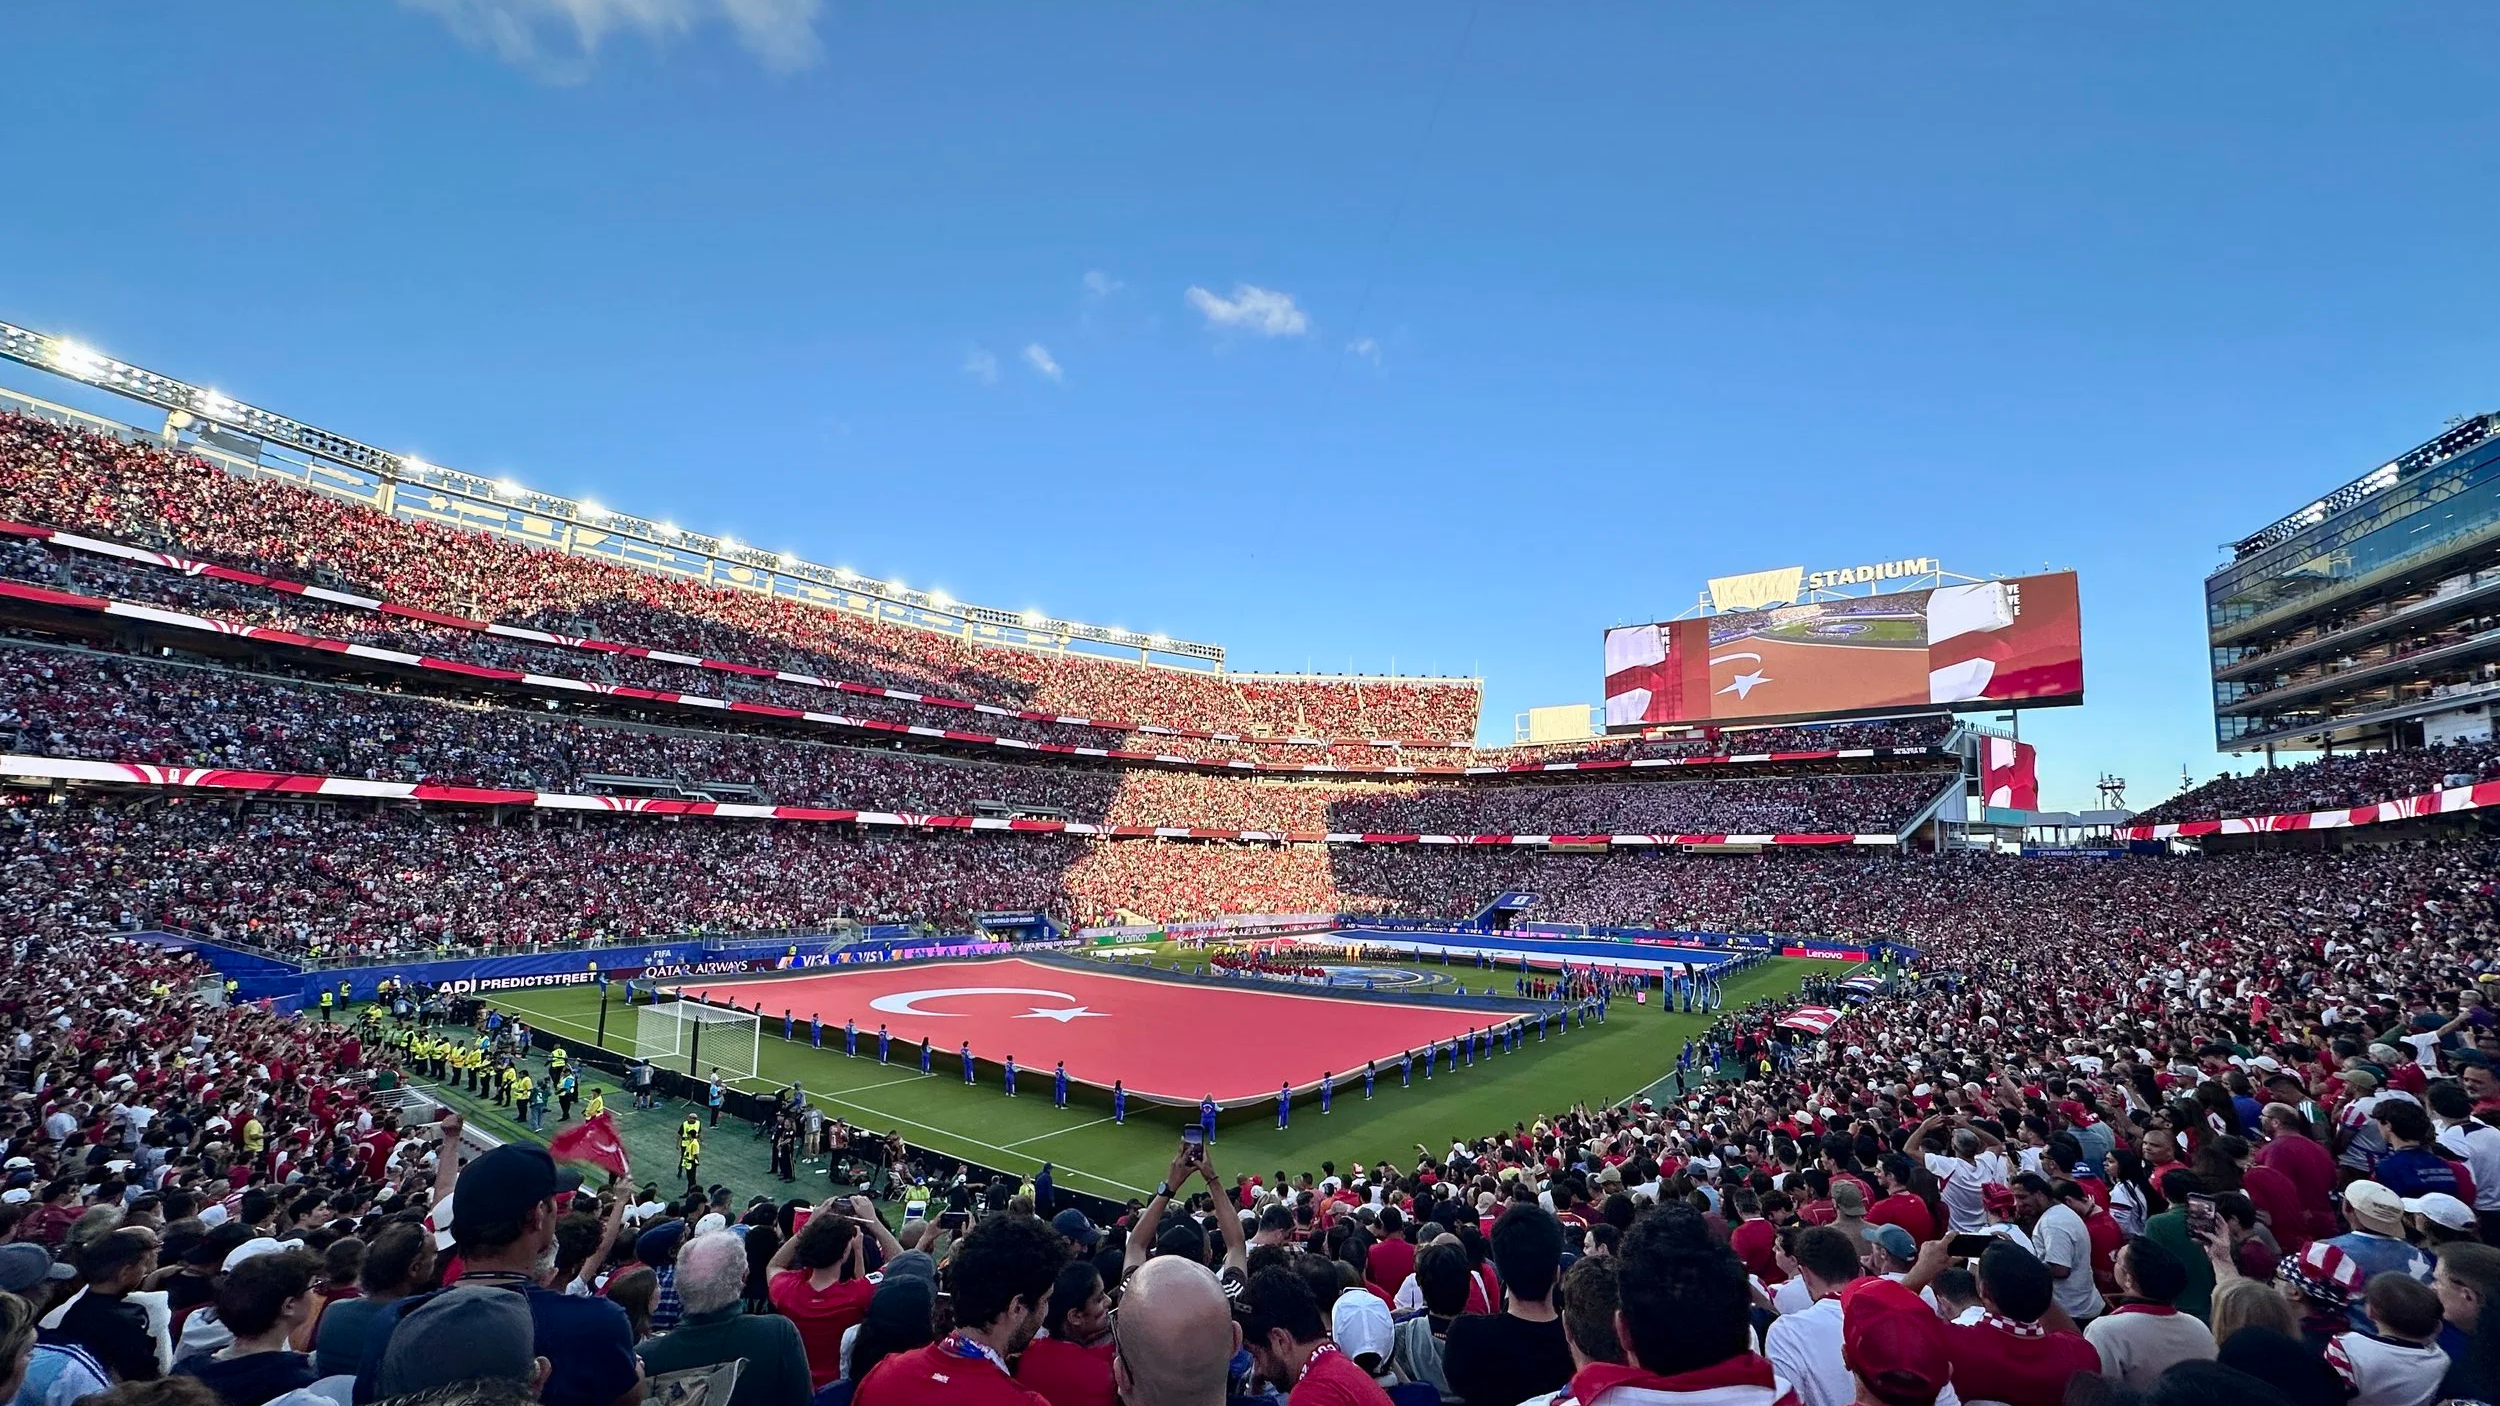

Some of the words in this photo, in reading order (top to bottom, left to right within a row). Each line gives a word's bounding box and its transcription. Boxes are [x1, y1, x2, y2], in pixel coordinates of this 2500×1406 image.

[1808, 557, 1927, 590] STADIUM
[1116, 933, 1147, 943] aramco
[653, 949, 672, 958] FIFA
[1807, 949, 1844, 960] Lenovo
[800, 954, 830, 967] VISA
[646, 965, 690, 979] QATAR
[695, 960, 748, 974] AIRWAYS
[439, 979, 477, 994] ADI
[480, 972, 598, 990] PREDICTSTREET
